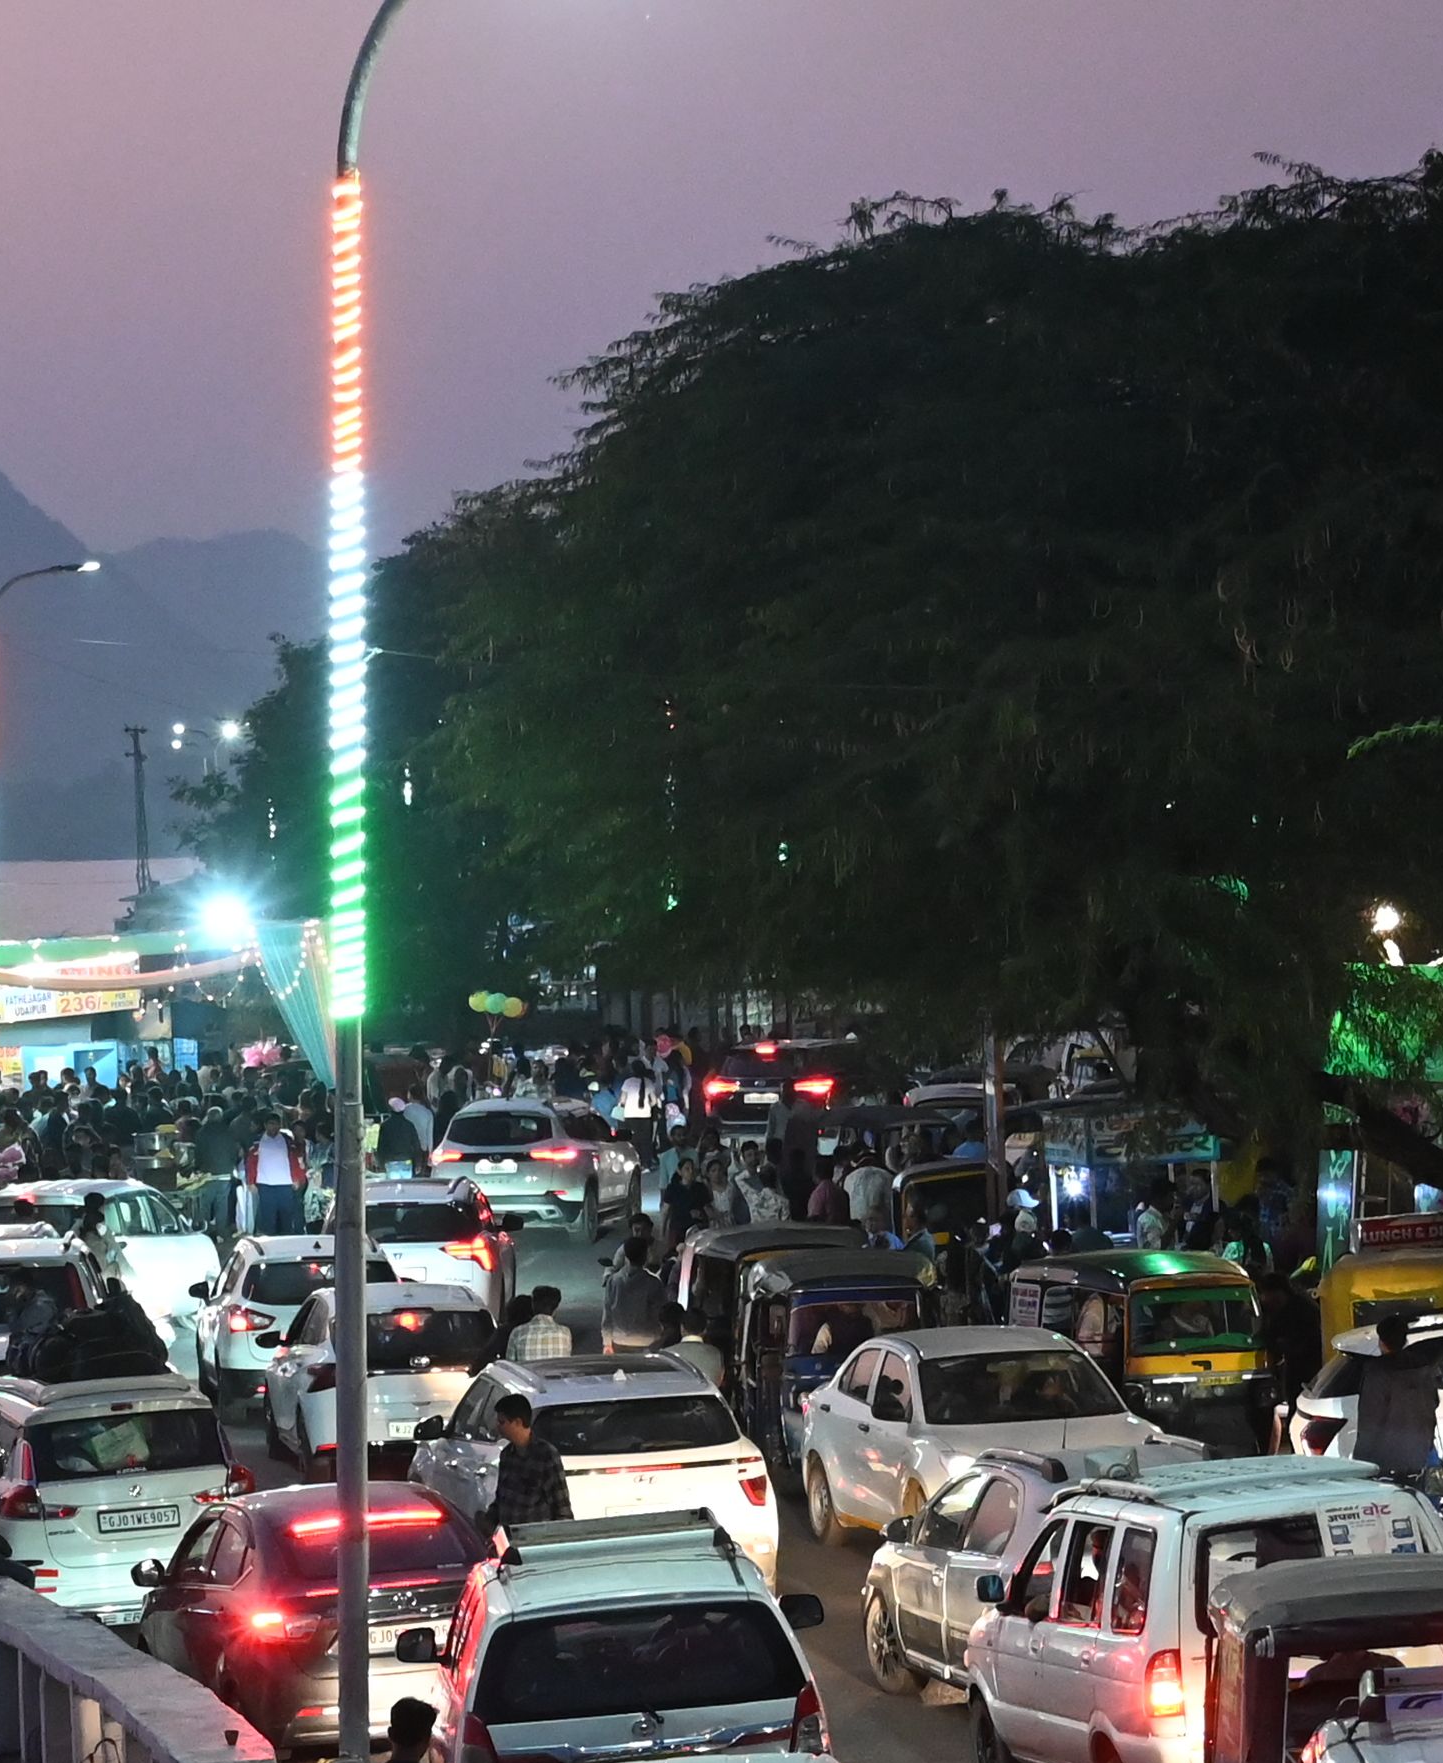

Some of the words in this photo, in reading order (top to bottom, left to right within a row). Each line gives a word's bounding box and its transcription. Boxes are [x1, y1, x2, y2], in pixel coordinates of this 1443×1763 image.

[1363, 1228, 1412, 1244] LUNCH
[1415, 1226, 1425, 1238] &
[108, 1510, 177, 1527] GJ01WE9057
